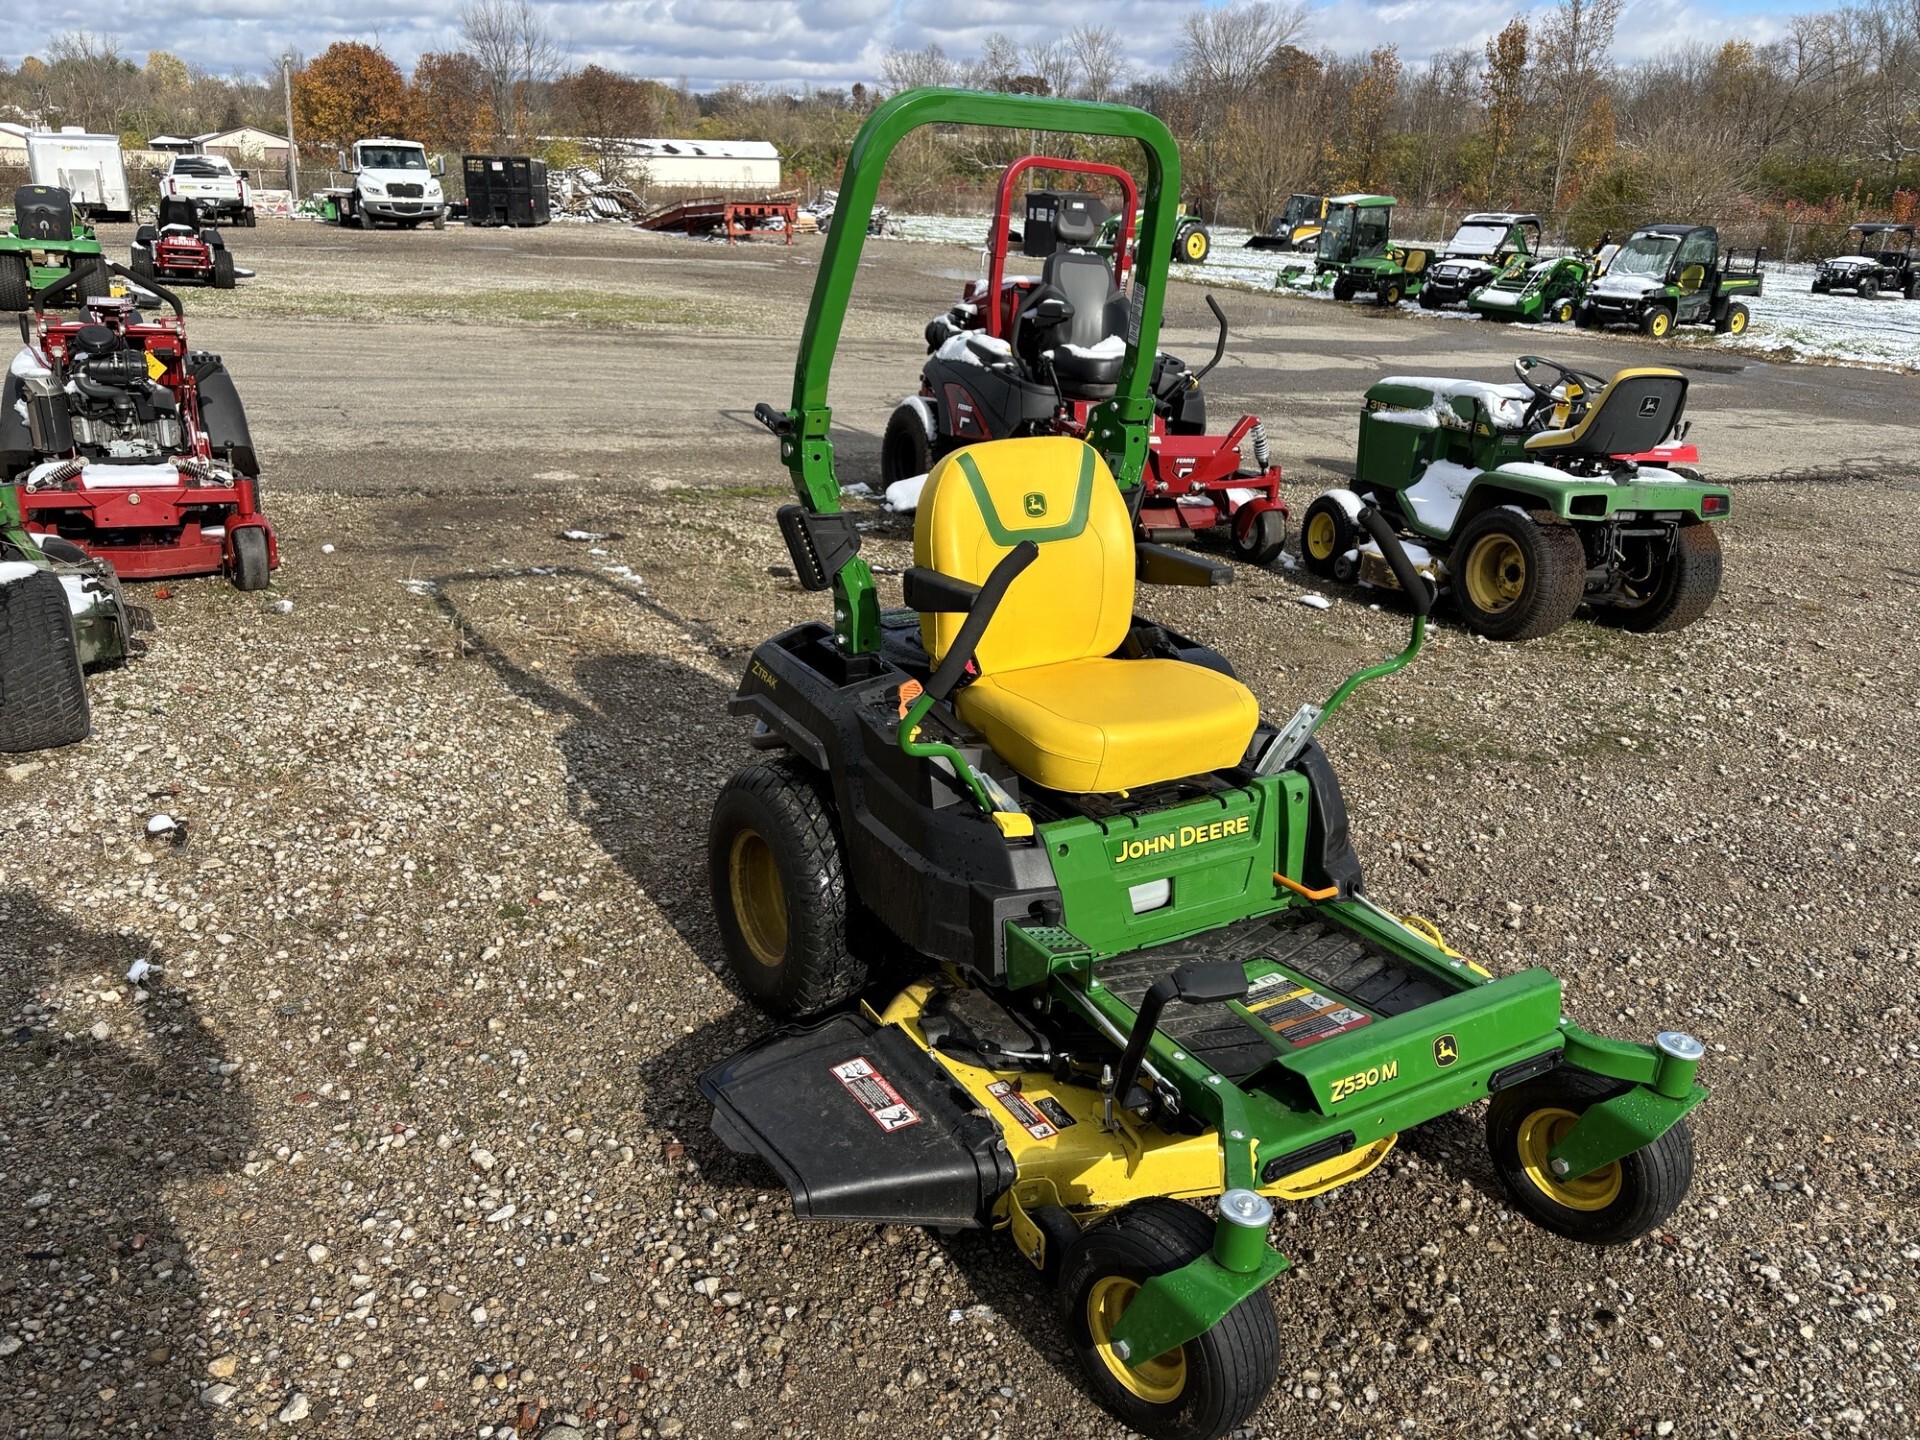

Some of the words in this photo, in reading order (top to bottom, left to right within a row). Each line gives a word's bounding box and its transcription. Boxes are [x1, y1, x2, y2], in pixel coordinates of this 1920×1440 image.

[1115, 833, 1175, 863] JOHN
[1180, 816, 1249, 847] DEERE
[1330, 1067, 1380, 1104] Z530
[1381, 1060, 1398, 1083] M
